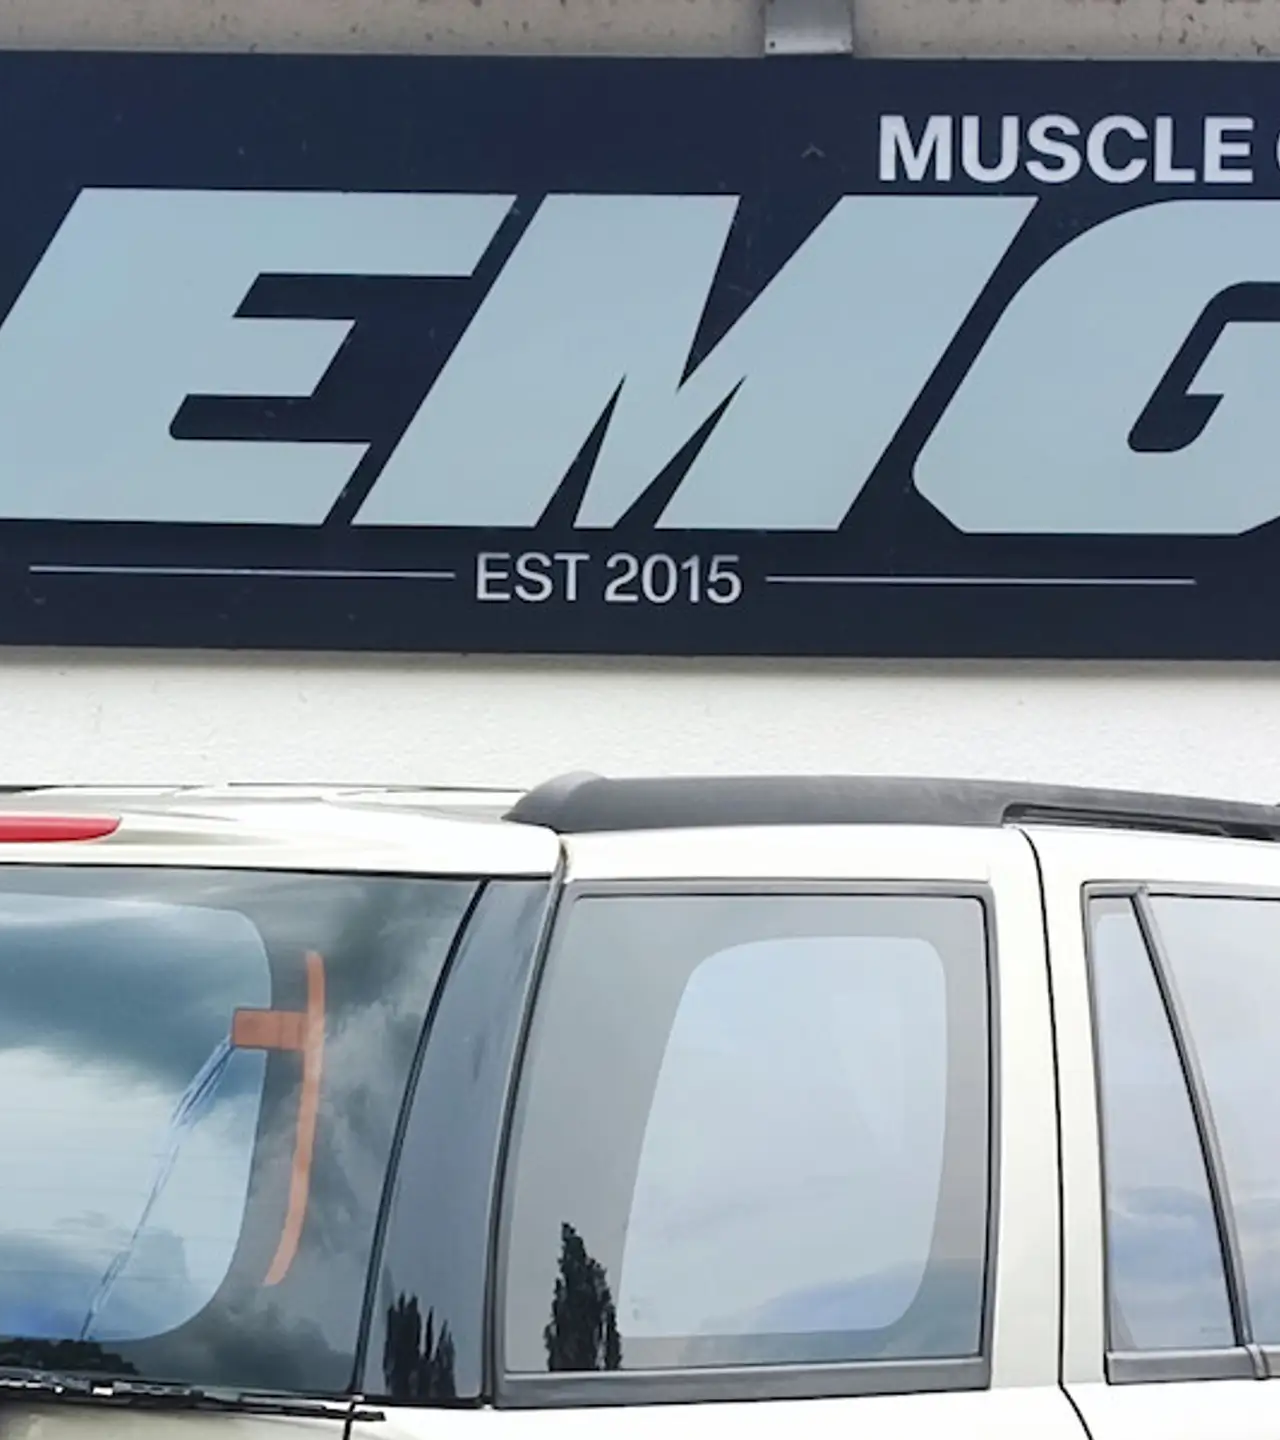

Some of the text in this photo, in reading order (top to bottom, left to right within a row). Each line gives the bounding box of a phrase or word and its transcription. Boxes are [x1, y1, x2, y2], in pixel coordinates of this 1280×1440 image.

[878, 114, 1255, 184] MUSCLE
[476, 552, 742, 604] EST 2015
